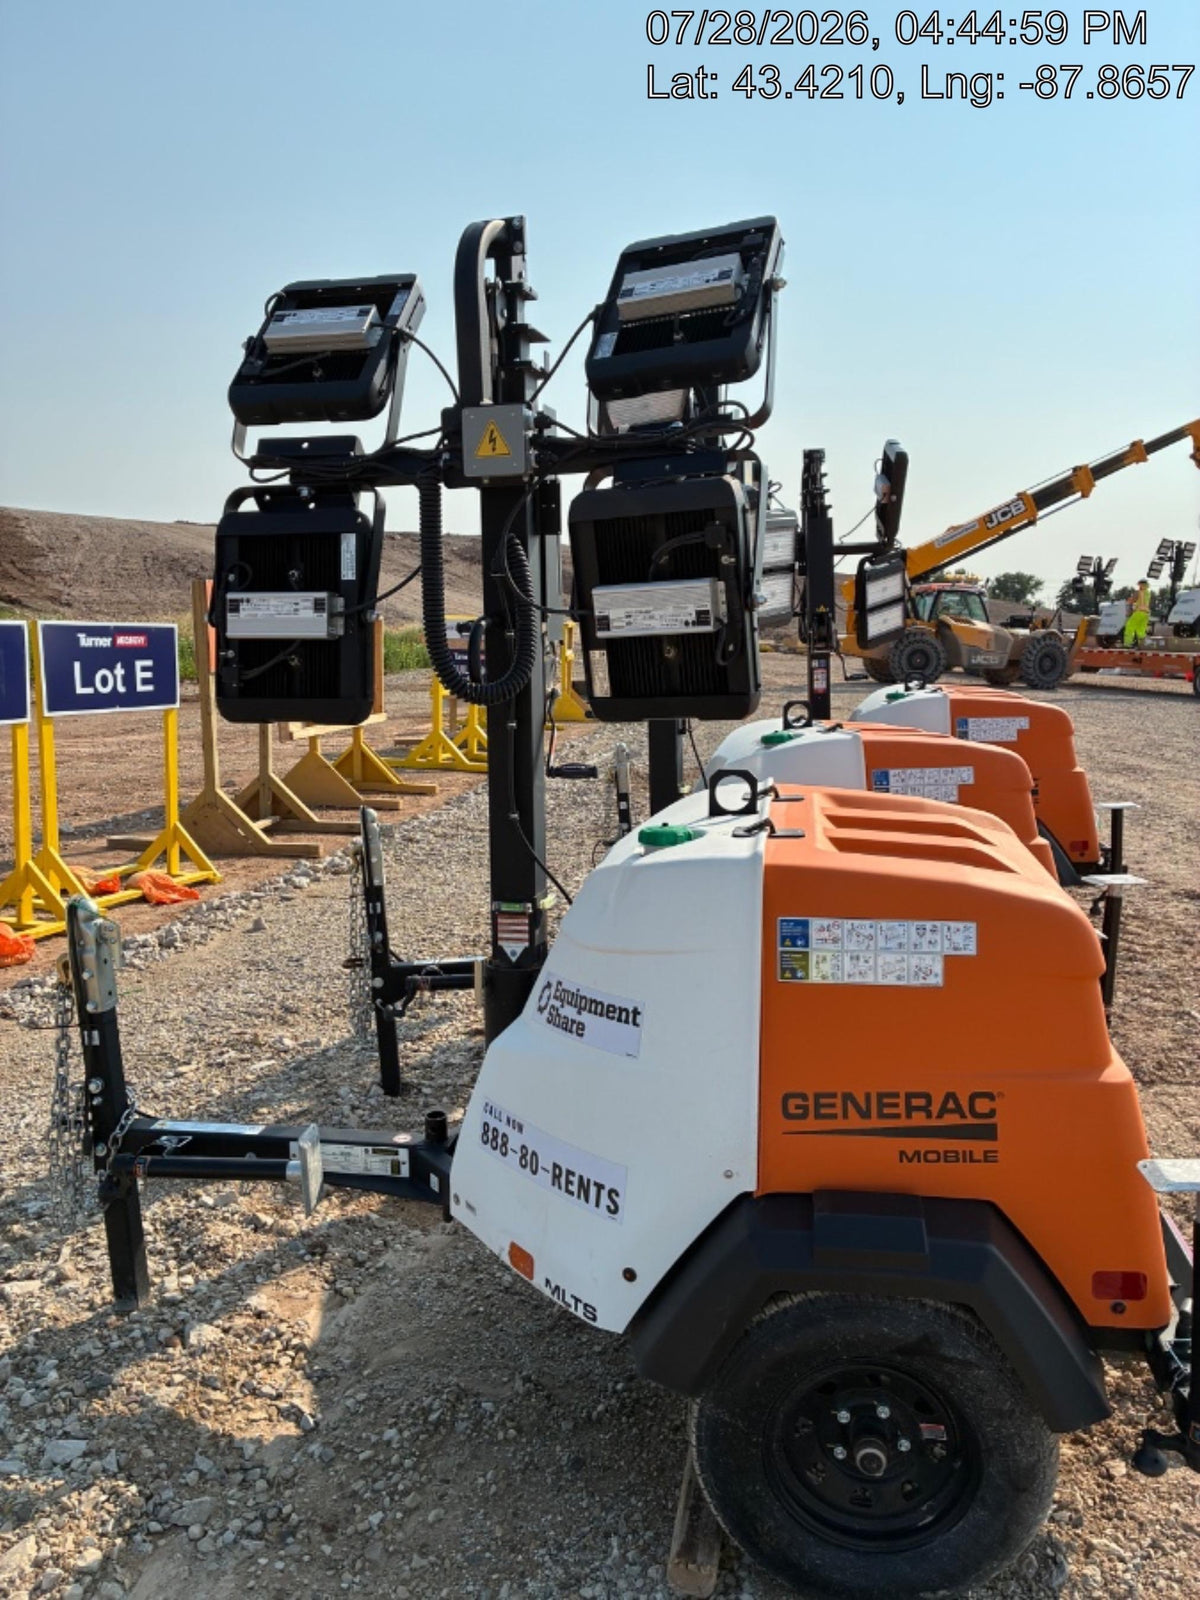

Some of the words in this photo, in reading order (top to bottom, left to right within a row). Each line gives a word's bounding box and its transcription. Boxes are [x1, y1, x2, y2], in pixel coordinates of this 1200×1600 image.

[986, 500, 1026, 528] JCB
[77, 632, 112, 647] Turner
[74, 661, 126, 694] Lot
[134, 659, 155, 692] E
[552, 980, 641, 1028] Equipment
[546, 1004, 585, 1038] Share
[483, 1102, 502, 1122] CALL
[506, 1115, 524, 1135] NOW
[781, 1091, 997, 1120] GENERAC
[481, 1121, 620, 1215] 888-80-RENTS
[899, 1150, 999, 1163] MOBILE
[545, 1278, 598, 1323] MLTS
